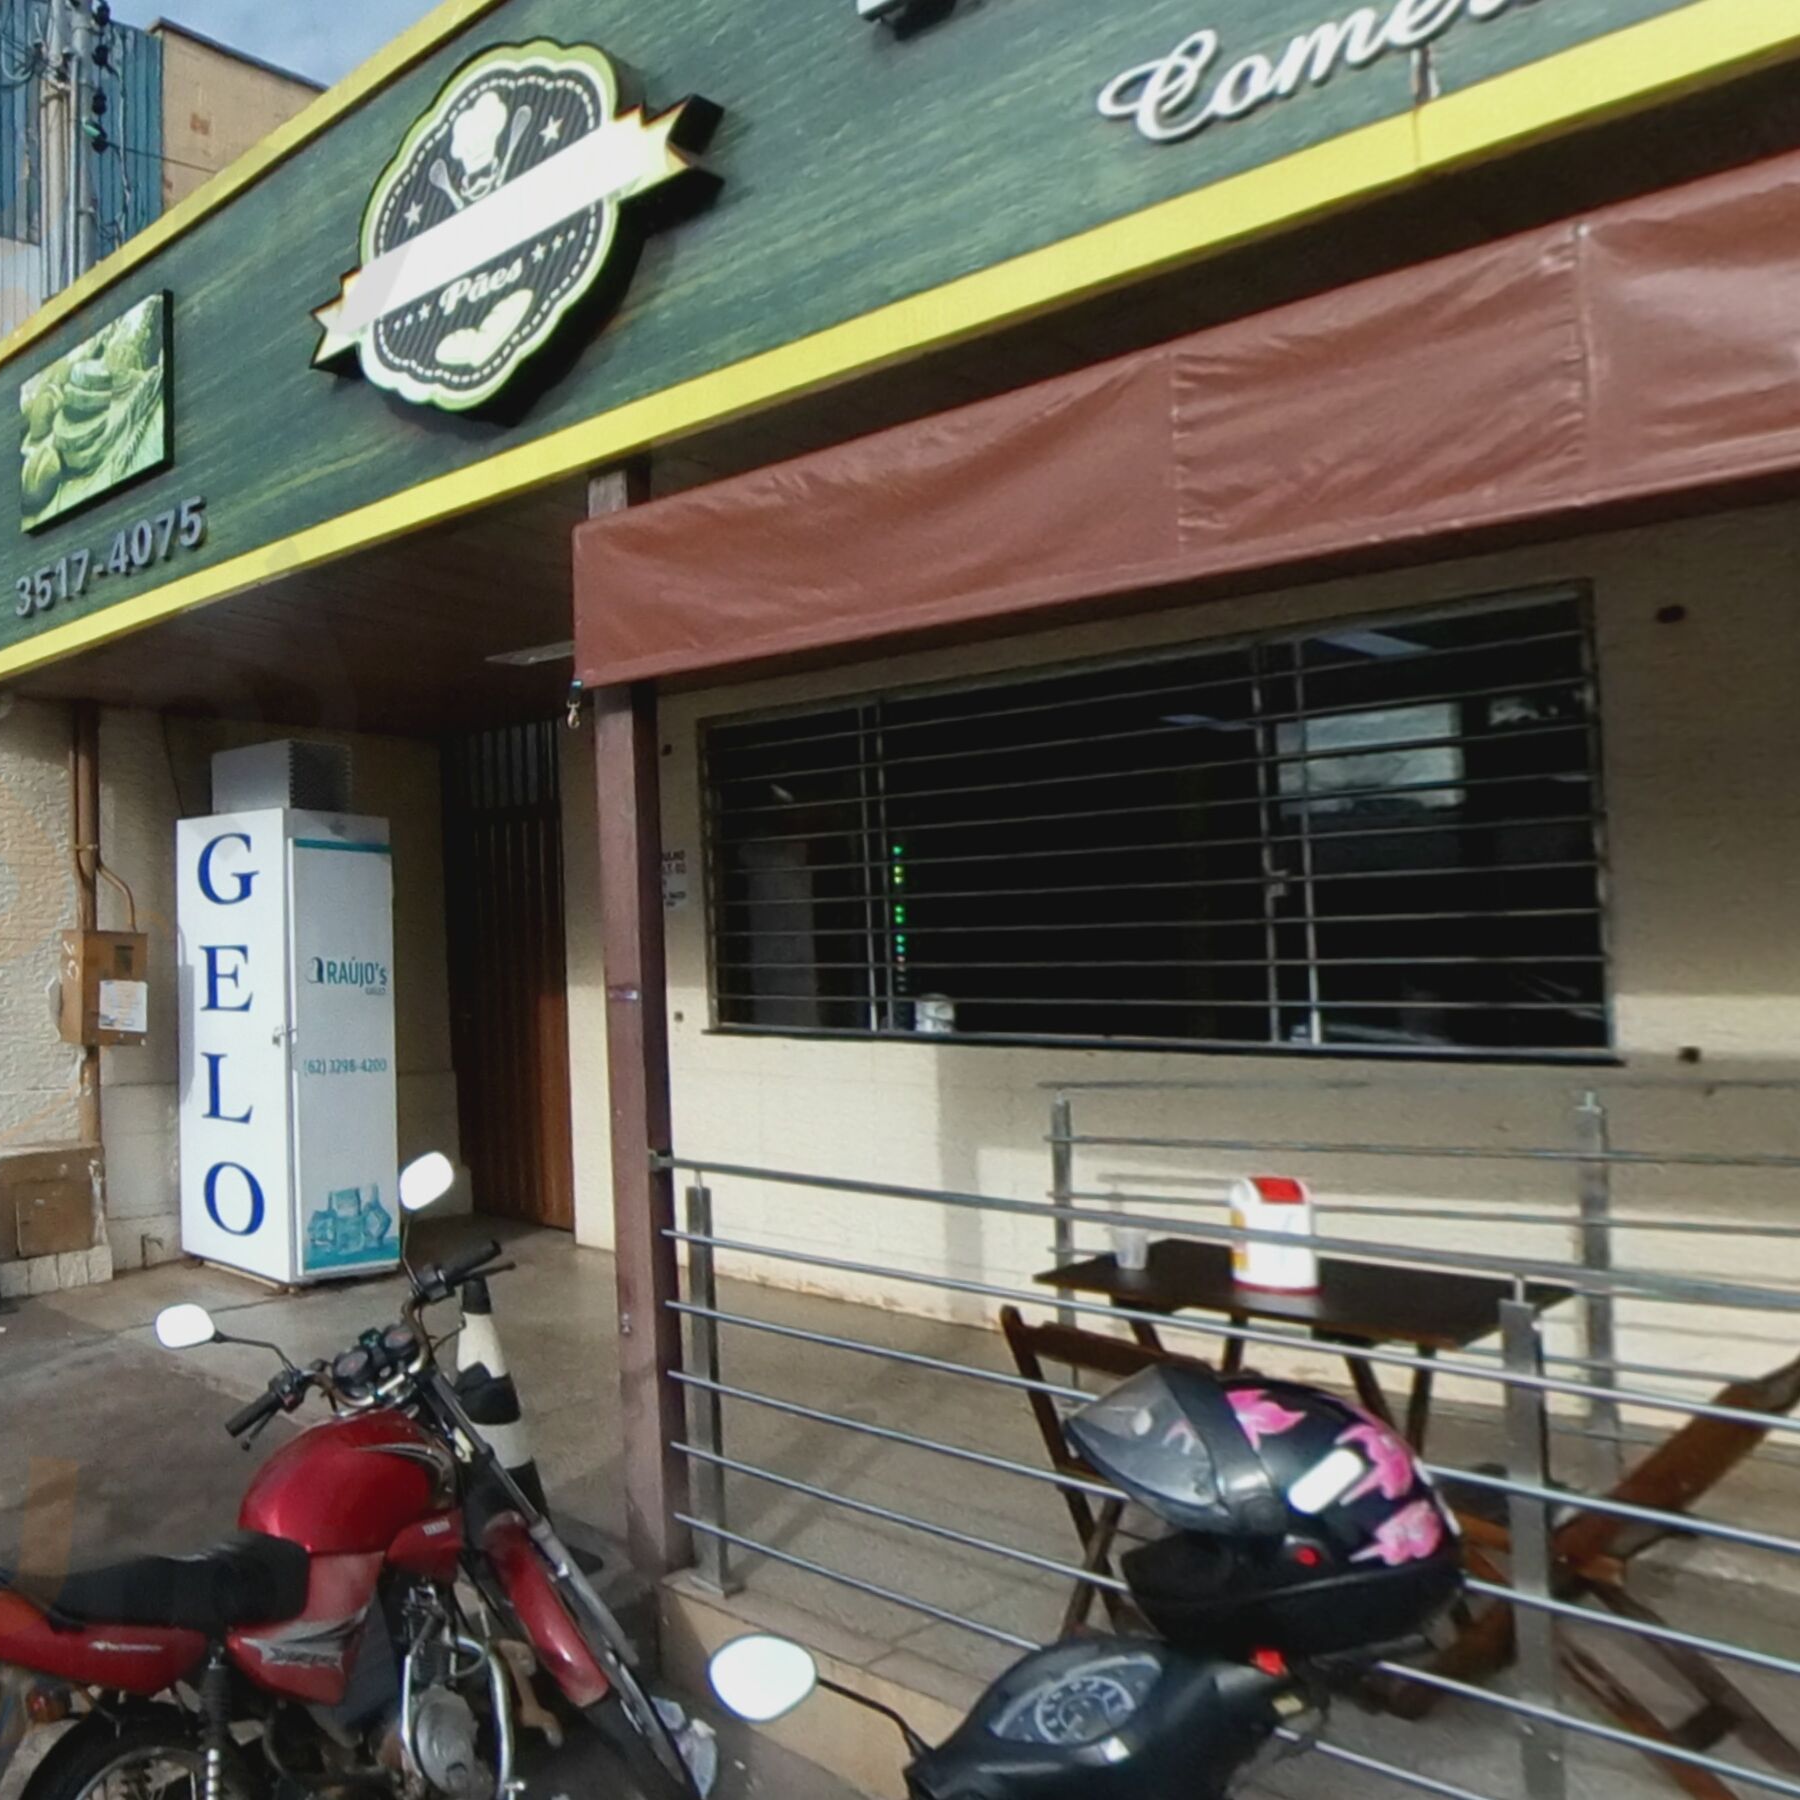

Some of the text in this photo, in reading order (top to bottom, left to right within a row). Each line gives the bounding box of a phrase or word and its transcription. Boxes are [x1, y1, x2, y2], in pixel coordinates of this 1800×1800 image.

[439, 257, 523, 316] Pães
[15, 496, 206, 617] 3517-4075
[197, 832, 265, 1237] GELO
